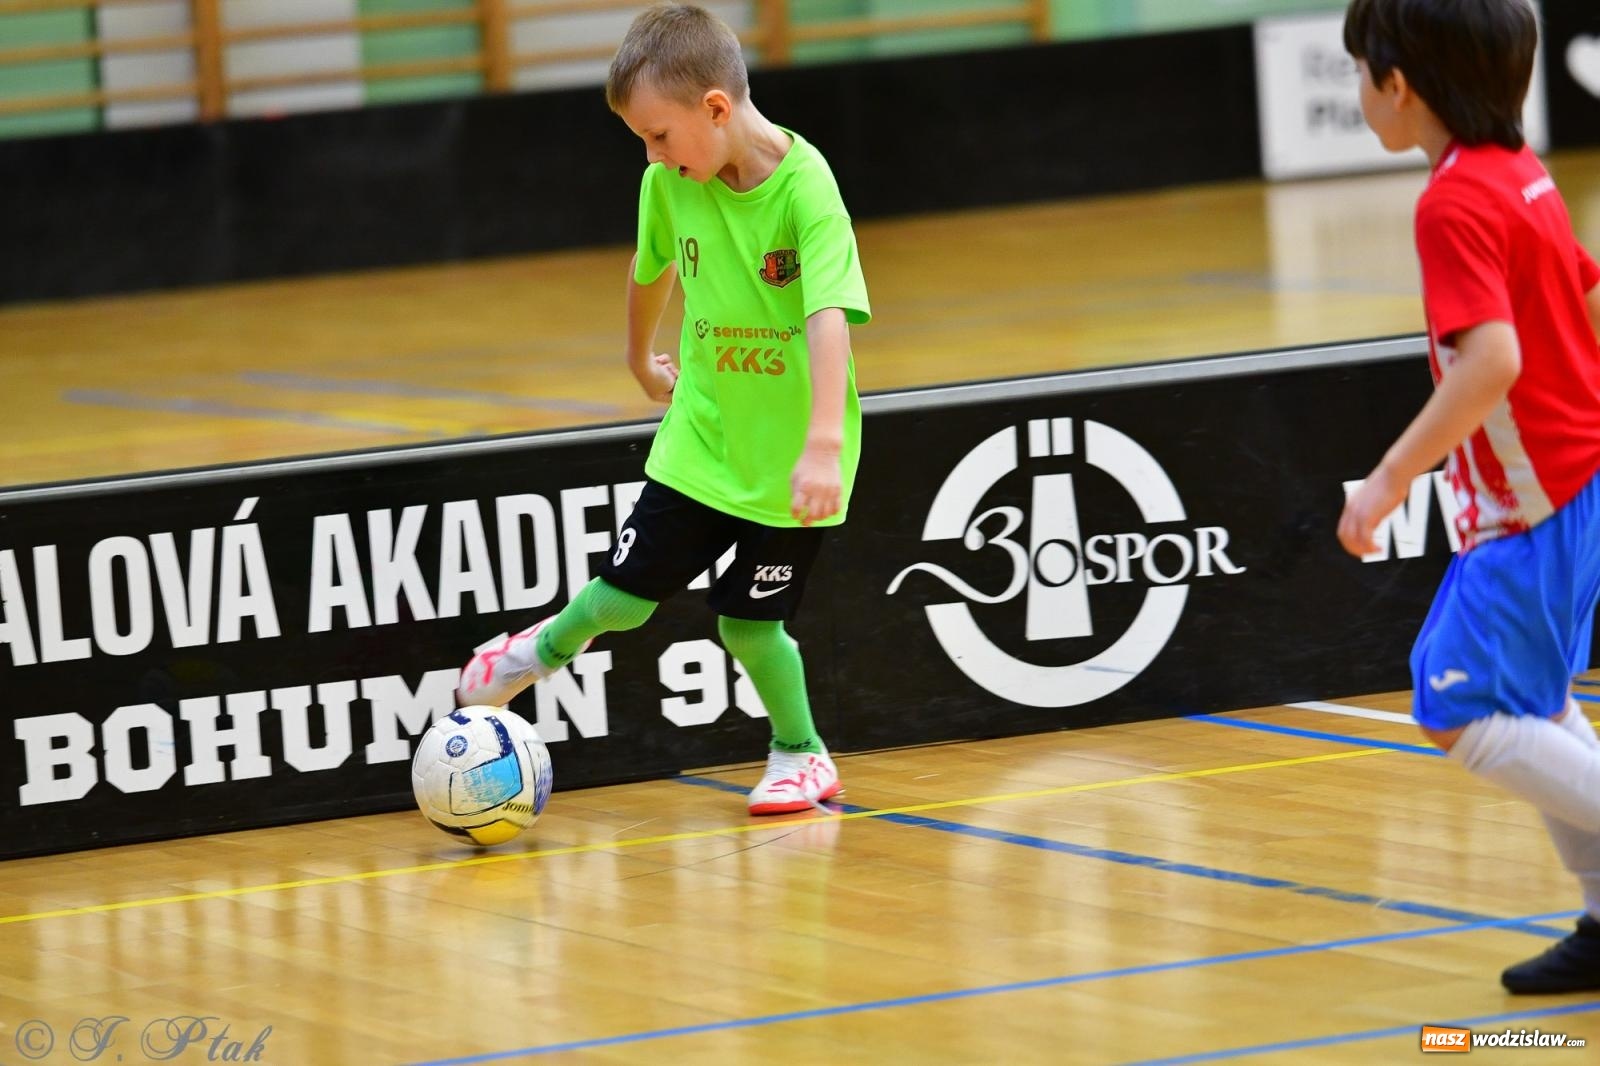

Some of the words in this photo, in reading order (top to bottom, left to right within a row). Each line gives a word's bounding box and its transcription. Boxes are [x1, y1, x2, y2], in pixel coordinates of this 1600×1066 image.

[678, 237, 699, 278] 19
[715, 346, 786, 376] KKS
[612, 527, 637, 567] 8
[754, 565, 793, 582] KKS
[14, 650, 614, 807] BOHUMN
